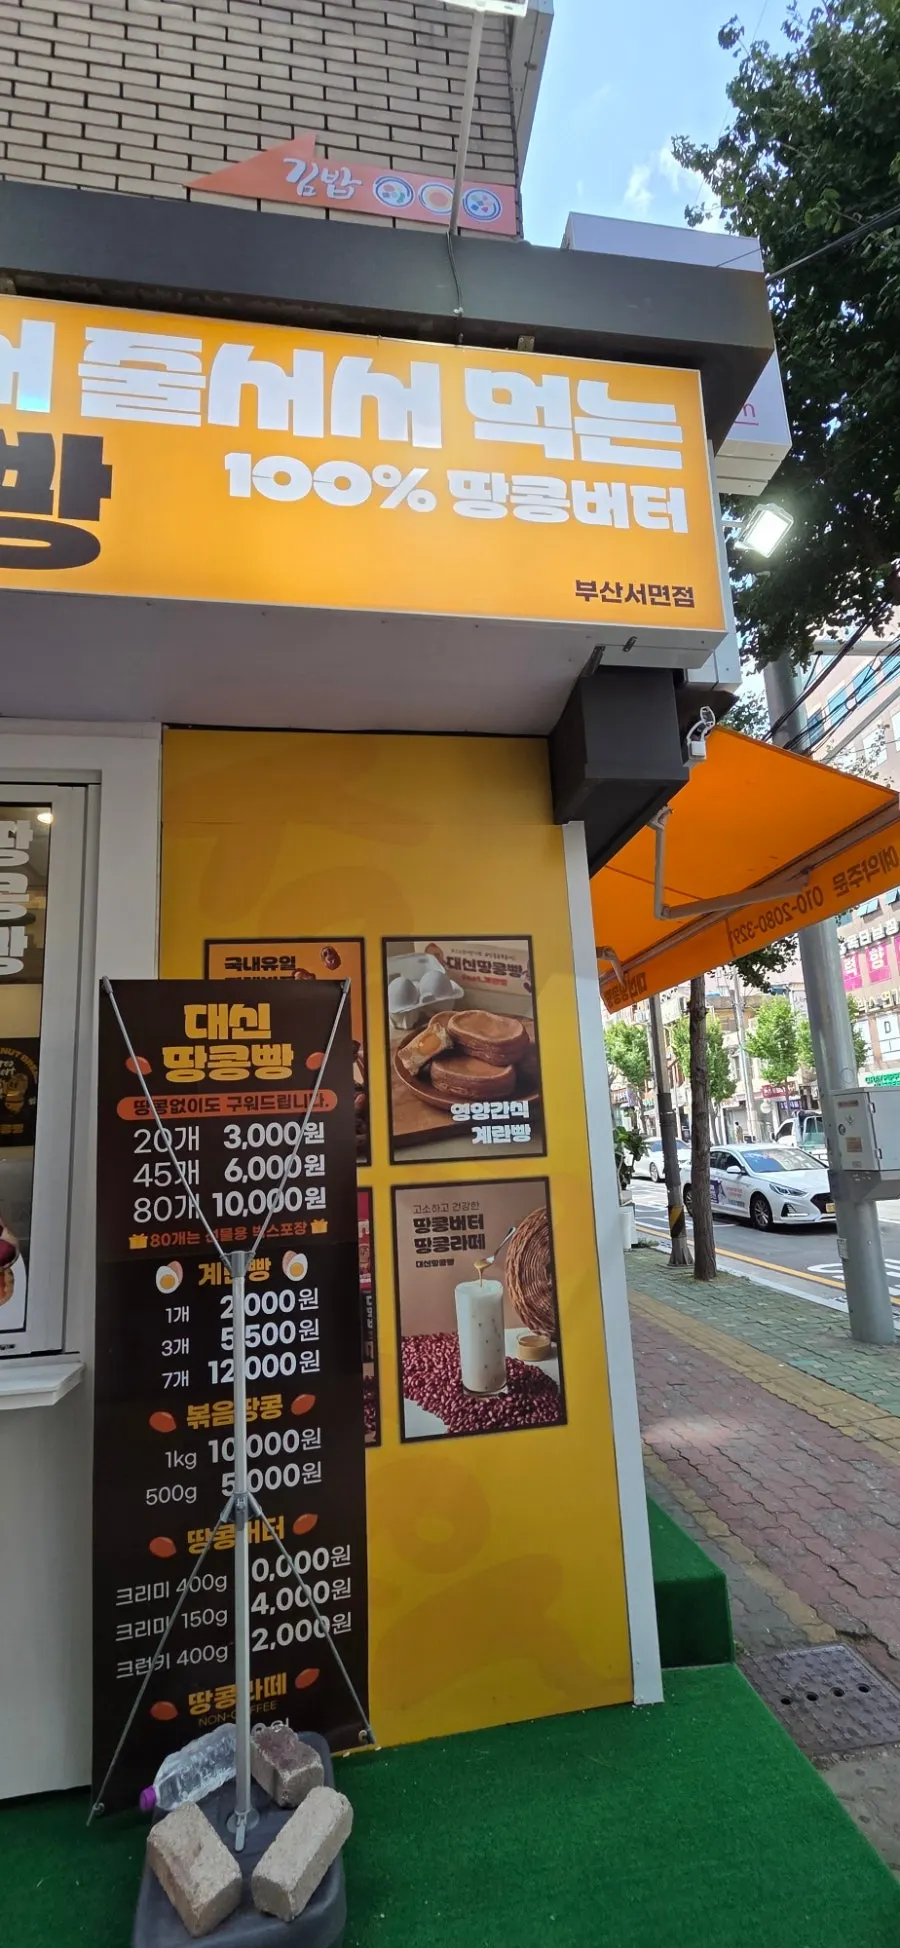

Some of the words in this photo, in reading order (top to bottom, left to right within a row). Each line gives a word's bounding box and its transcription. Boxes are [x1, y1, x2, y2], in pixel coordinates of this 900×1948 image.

[283, 158, 363, 199] 김밥
[78, 327, 443, 449] 줄서서
[464, 367, 683, 470] 먹는
[224, 452, 437, 512] 100%
[447, 469, 689, 533] 땅콩버터
[575, 580, 695, 609] 부산서면점
[224, 955, 296, 972] 국내유일
[183, 1003, 272, 1040] 대신
[162, 1043, 294, 1083] 땅콩빵
[133, 1097, 221, 1116] 땅콩없이도
[226, 1092, 329, 1112] 구워드립니다.
[451, 1100, 530, 1122] 영양간식
[133, 1125, 200, 1154] 20개
[223, 1121, 325, 1150] 3,000원
[472, 1124, 532, 1145] 계란빵
[132, 1160, 200, 1188] 45개
[224, 1154, 326, 1184] 6,000원
[133, 1192, 200, 1223] 80개
[212, 1186, 327, 1217] 10,000원
[413, 1203, 449, 1215] 고소하고
[452, 1201, 480, 1213] 건강한
[150, 1231, 201, 1248] 80개는
[413, 1213, 485, 1234] 땅콩버터
[414, 1233, 486, 1255] 땅콩라떼
[198, 1257, 272, 1286] 계빵
[165, 1306, 190, 1324] 1개
[220, 1287, 319, 1320] 2000원
[161, 1338, 190, 1356] 3개
[220, 1318, 320, 1351] 5500원
[162, 1370, 190, 1389] 7개
[207, 1349, 321, 1385] 12000원
[165, 1450, 198, 1470] 1kg
[208, 1427, 322, 1464] 10000원
[146, 1485, 198, 1506] 500g
[221, 1461, 323, 1497] 5000원
[115, 1580, 170, 1606] 크리미
[175, 1573, 228, 1593] 400g
[251, 1544, 352, 1583] 0,000원
[115, 1615, 170, 1642] 크리미
[180, 1608, 229, 1629] 150g
[116, 1652, 171, 1679] 크런키
[176, 1644, 229, 1667] 400g
[251, 1611, 352, 1653] 2,000원
